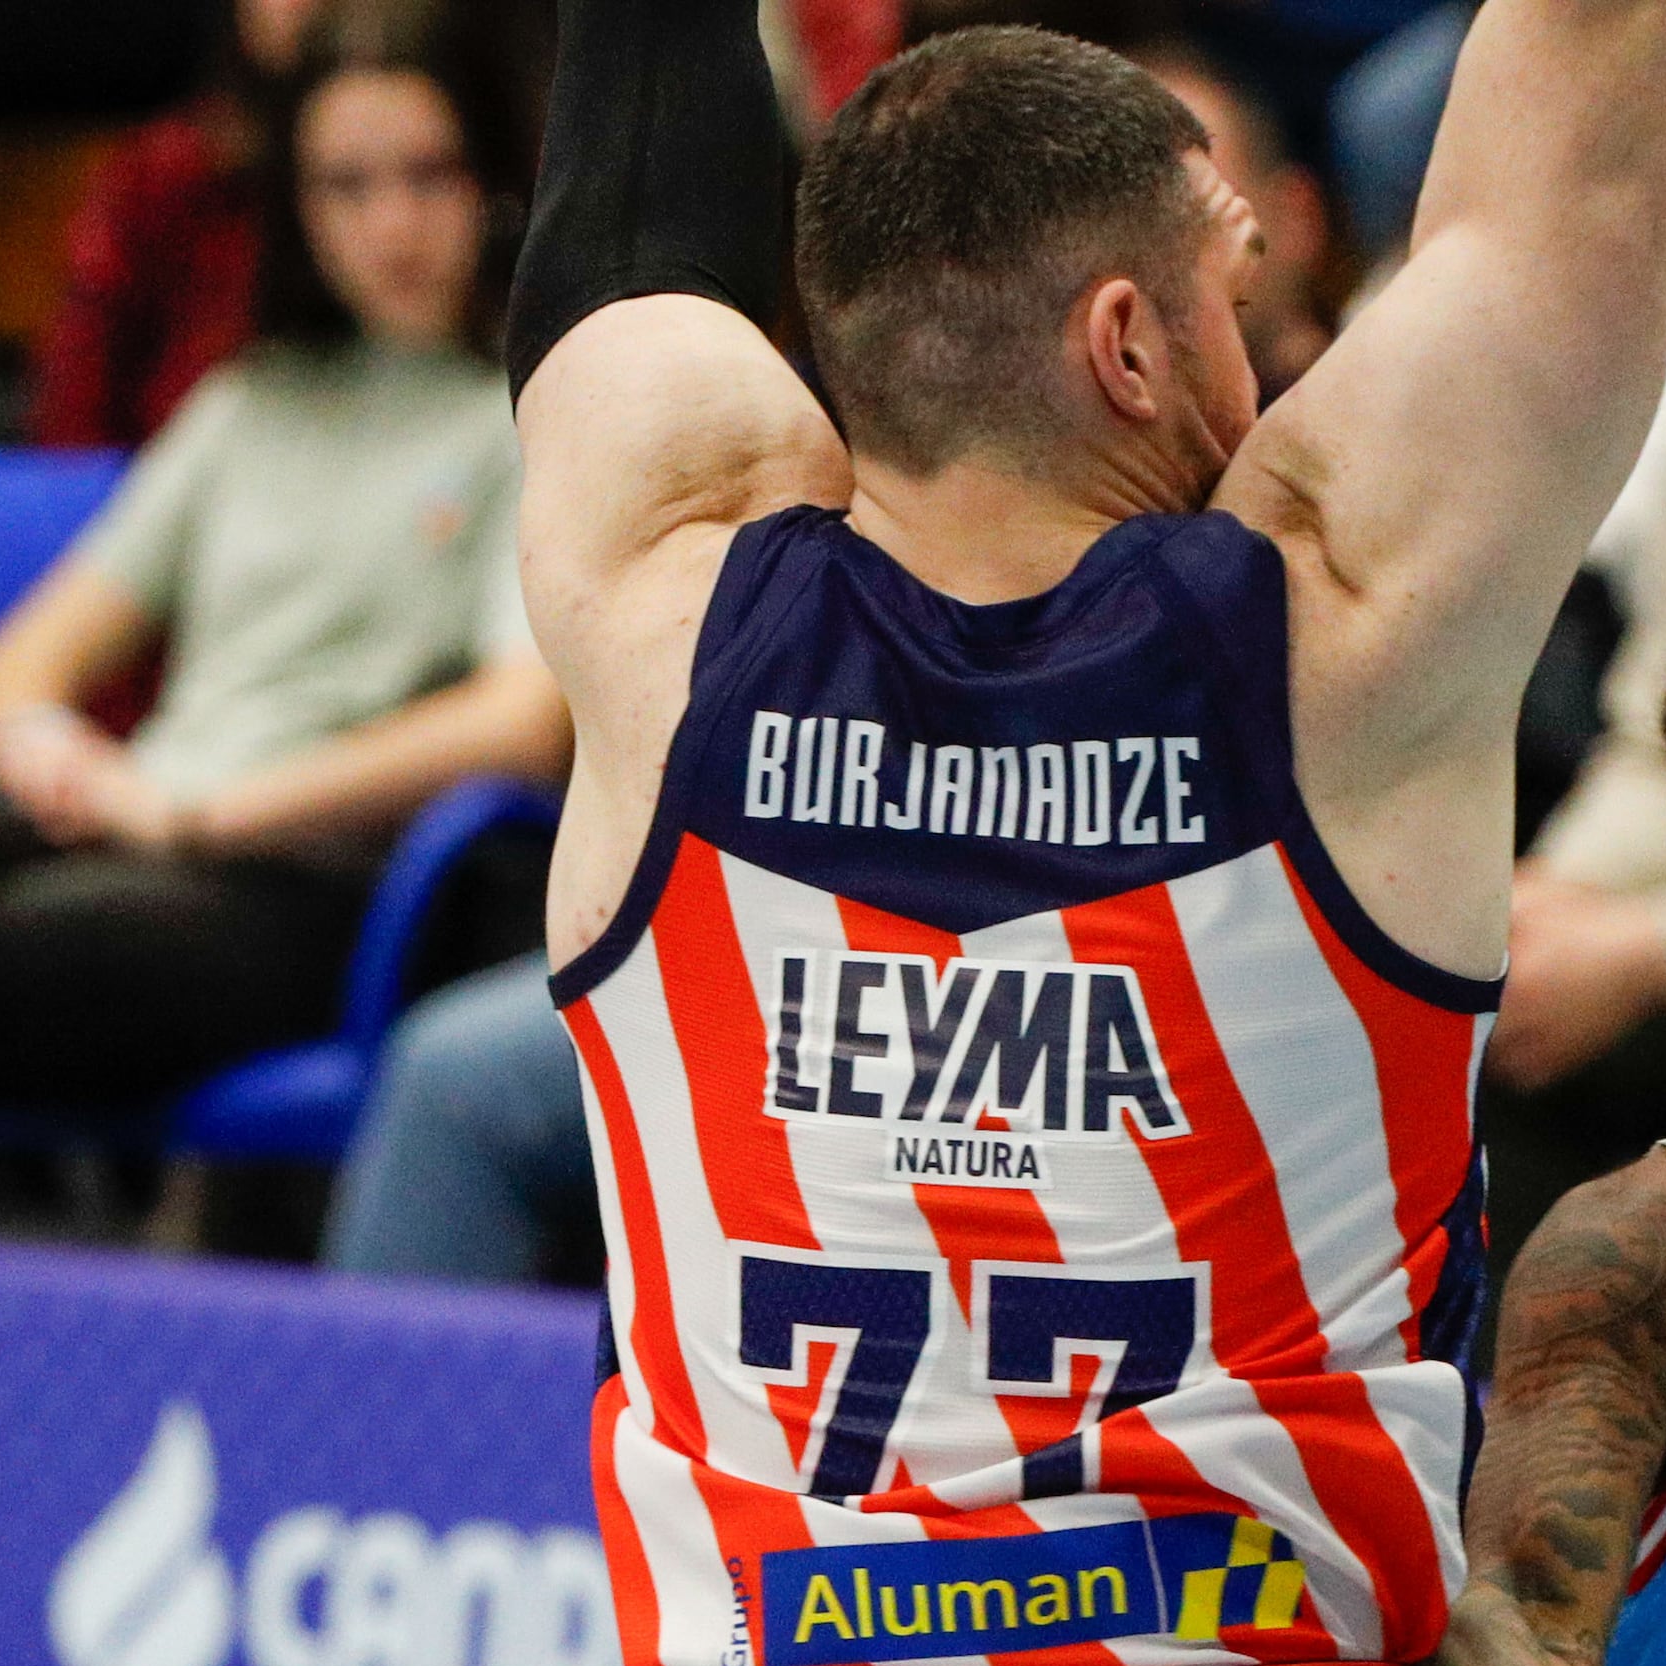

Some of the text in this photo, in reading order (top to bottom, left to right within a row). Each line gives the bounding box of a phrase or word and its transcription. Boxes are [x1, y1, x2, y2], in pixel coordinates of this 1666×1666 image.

[744, 709, 1206, 846] BURJANADZE
[773, 956, 1179, 1134] LEYMA
[894, 1136, 1041, 1180] NATURA
[738, 1255, 1197, 1505] 77
[794, 1565, 1128, 1643] Aluman
